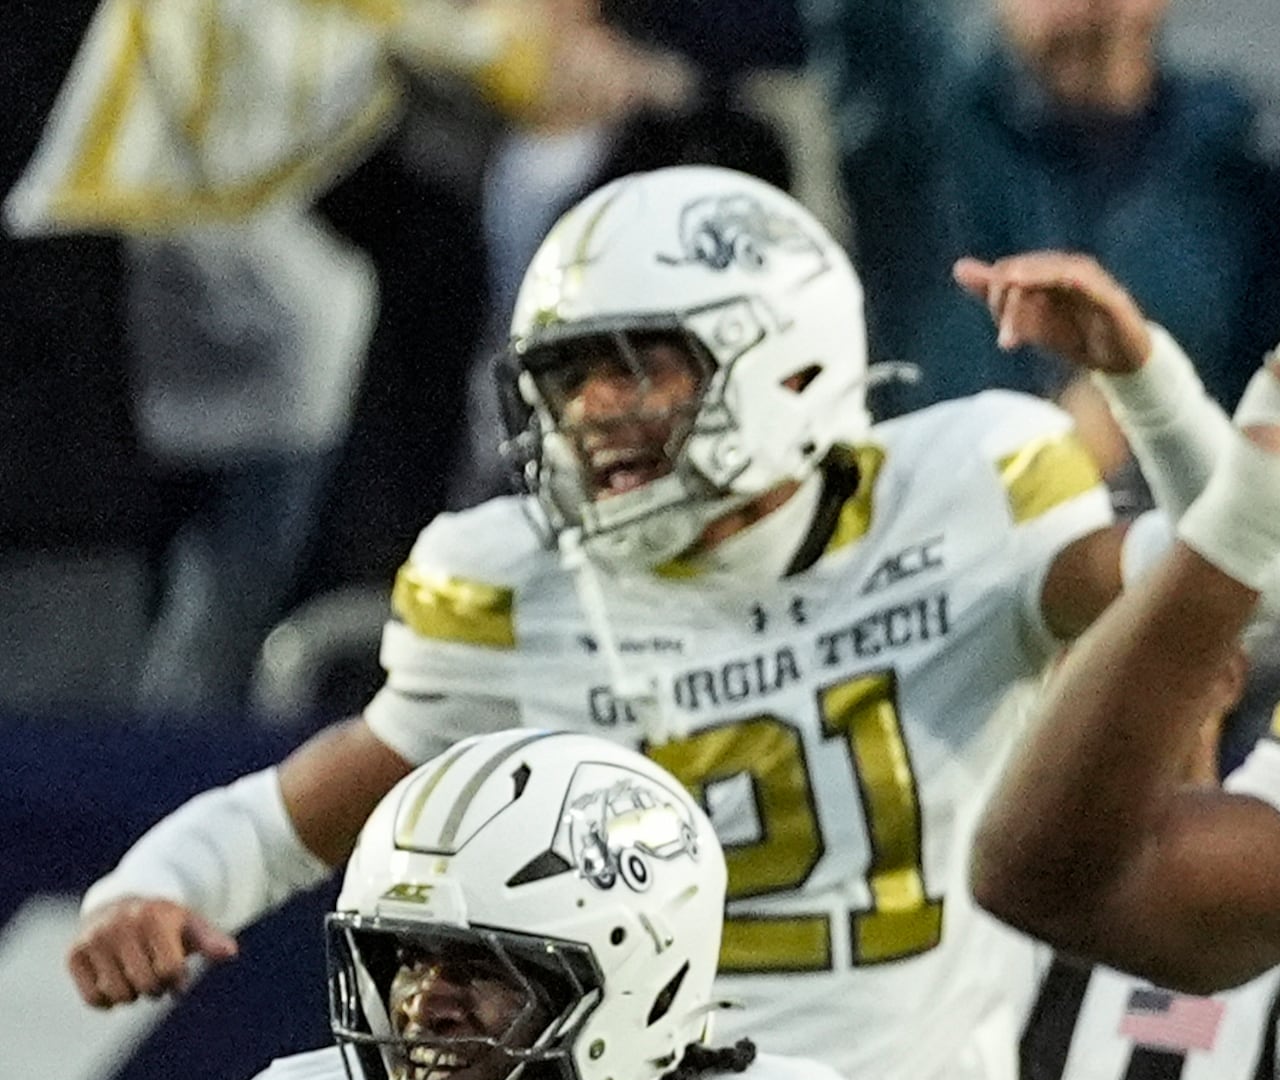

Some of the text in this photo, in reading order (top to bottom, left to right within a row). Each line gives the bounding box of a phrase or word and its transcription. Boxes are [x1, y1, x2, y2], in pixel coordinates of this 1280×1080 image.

[860, 535, 945, 596] ACC
[588, 593, 950, 726] GRGIA TECH
[641, 668, 945, 974] 21
